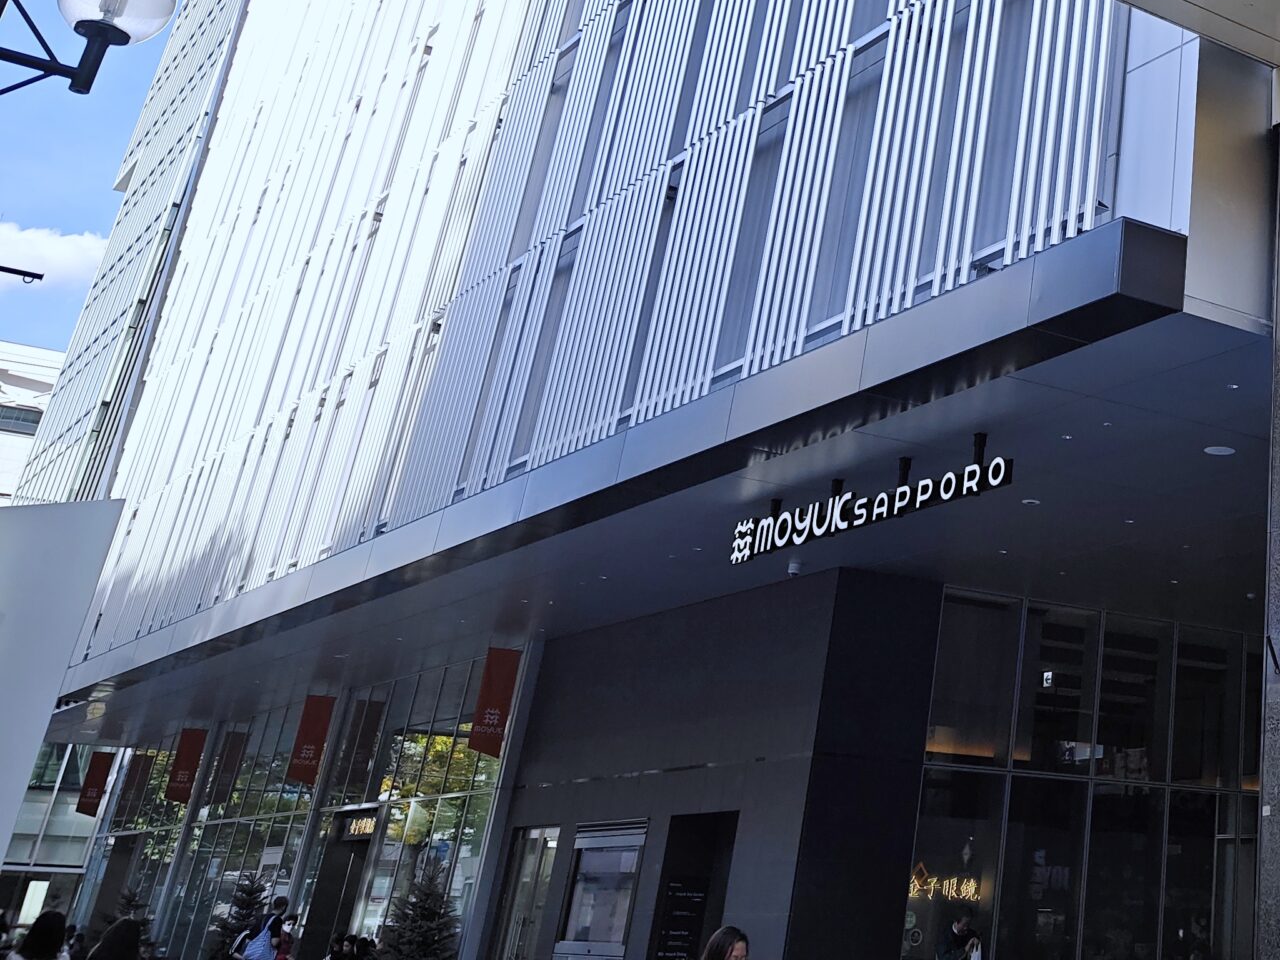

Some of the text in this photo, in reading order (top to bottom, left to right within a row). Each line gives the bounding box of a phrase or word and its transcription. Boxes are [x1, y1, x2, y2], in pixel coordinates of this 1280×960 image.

[853, 456, 1006, 527] SAPPORO
[908, 875, 981, 901] 金子眼鏡
